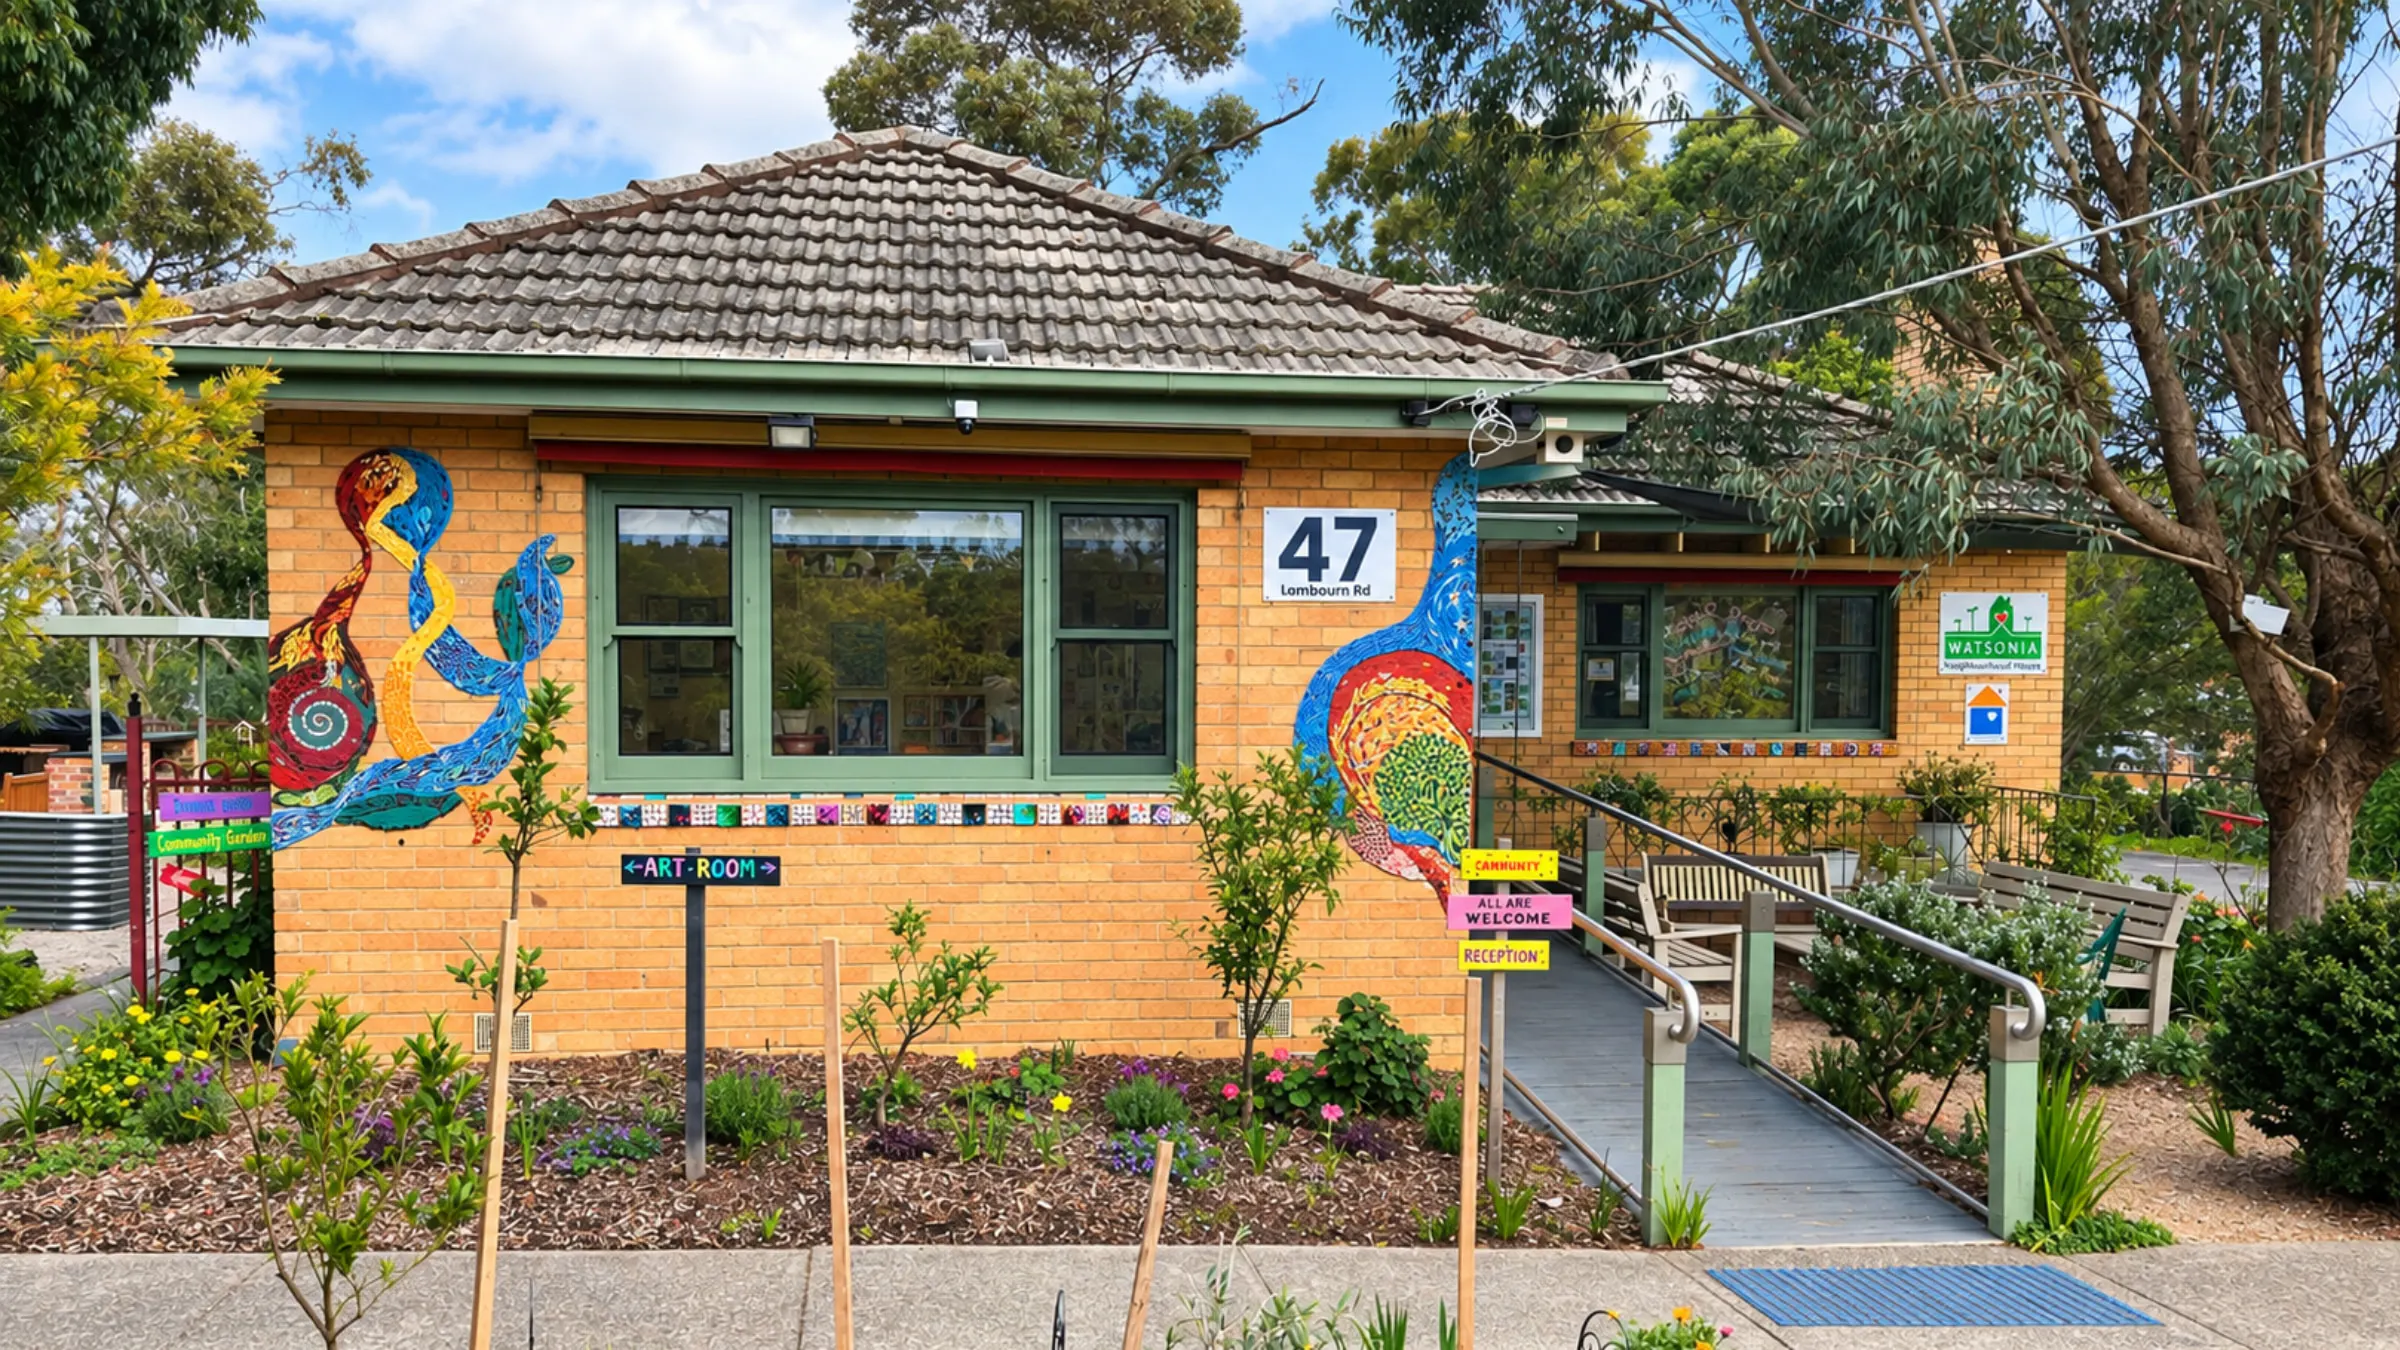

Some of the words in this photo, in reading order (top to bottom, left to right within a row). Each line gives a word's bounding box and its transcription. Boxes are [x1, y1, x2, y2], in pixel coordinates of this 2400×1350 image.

[1279, 516, 1377, 582] 47
[1353, 584, 1371, 596] Rd
[1948, 641, 2038, 655] WATSONIA
[157, 832, 221, 852] Community
[226, 828, 267, 844] Garden
[1478, 898, 1502, 909] ALL
[1506, 897, 1532, 909] ARE
[1465, 912, 1551, 925] WELCOME
[1464, 948, 1538, 963] RECEPTION
